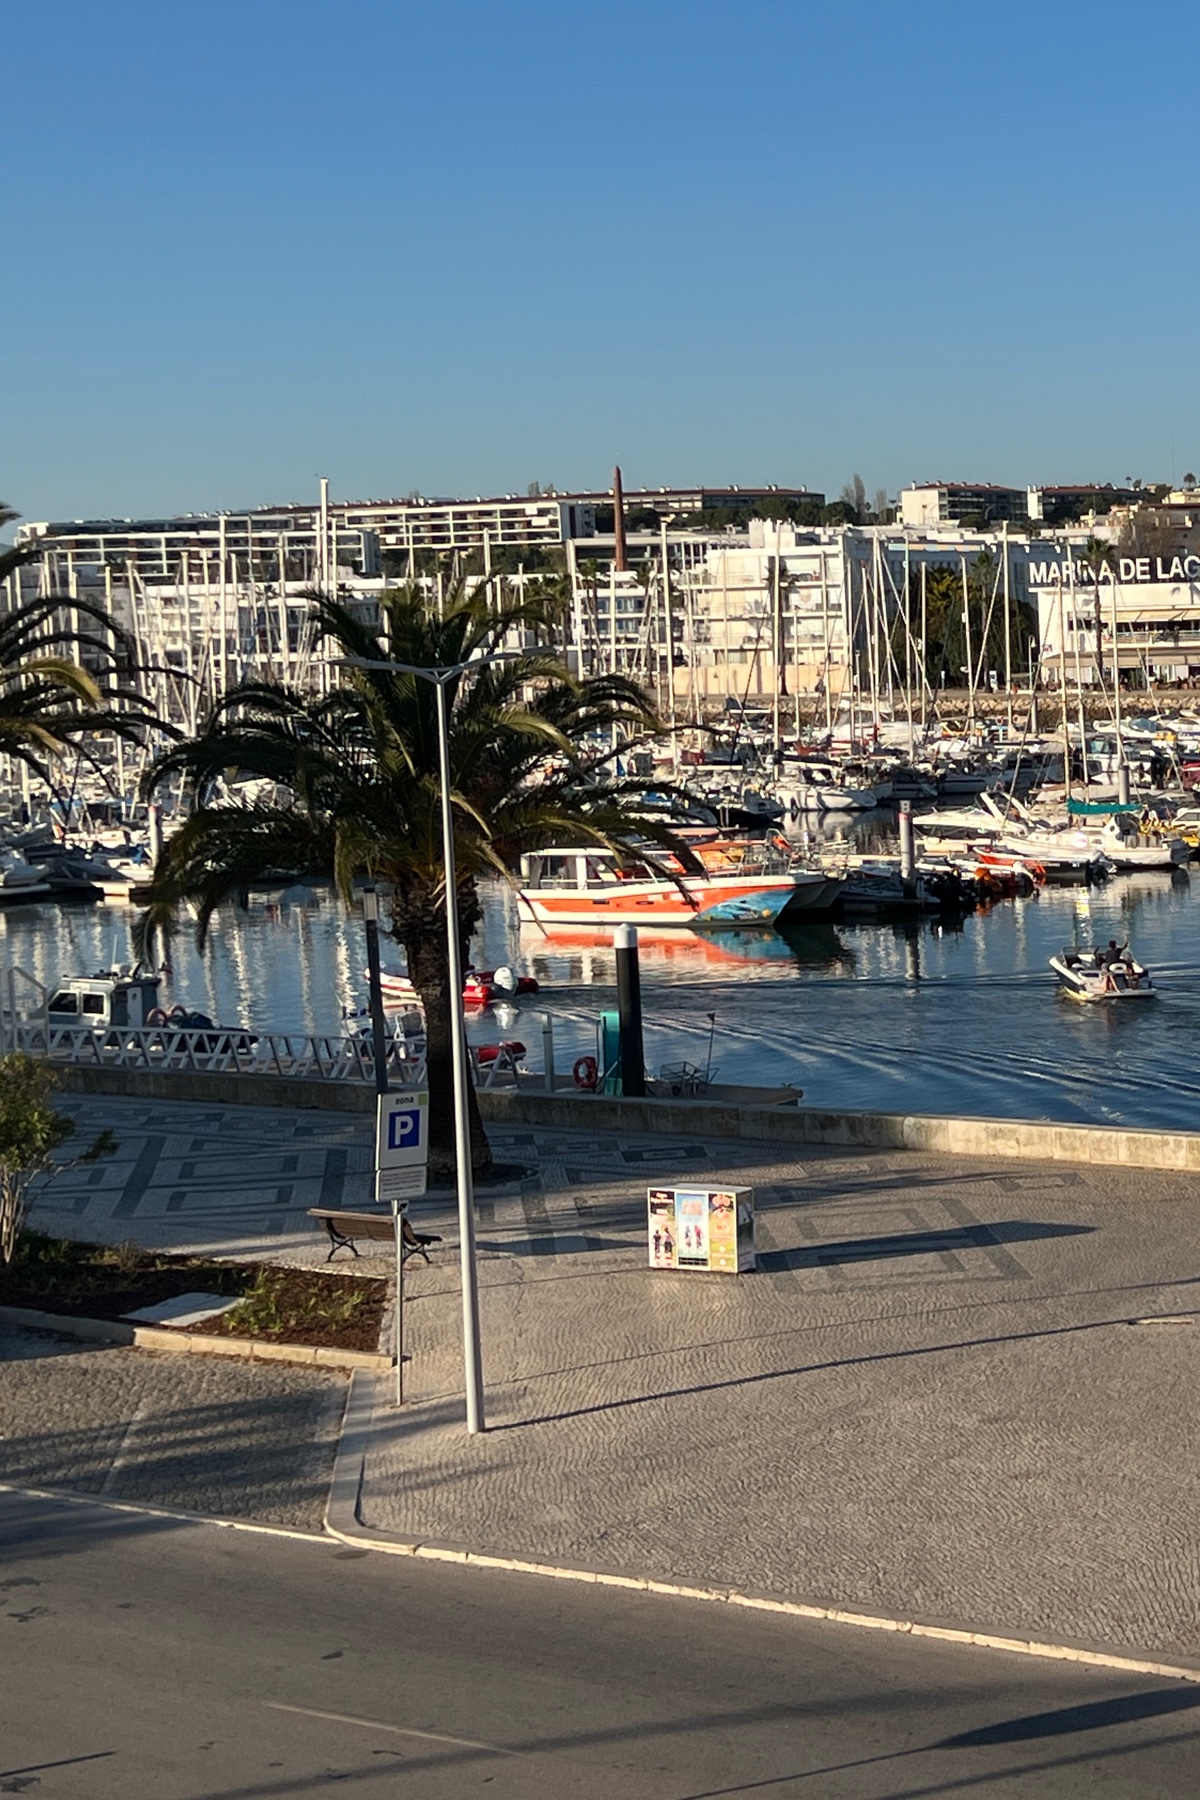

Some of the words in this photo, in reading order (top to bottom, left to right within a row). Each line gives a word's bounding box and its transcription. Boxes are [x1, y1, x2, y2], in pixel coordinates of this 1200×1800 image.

[1119, 558, 1150, 581] DE
[395, 1096, 414, 1105] zona
[394, 1115, 414, 1146] P
